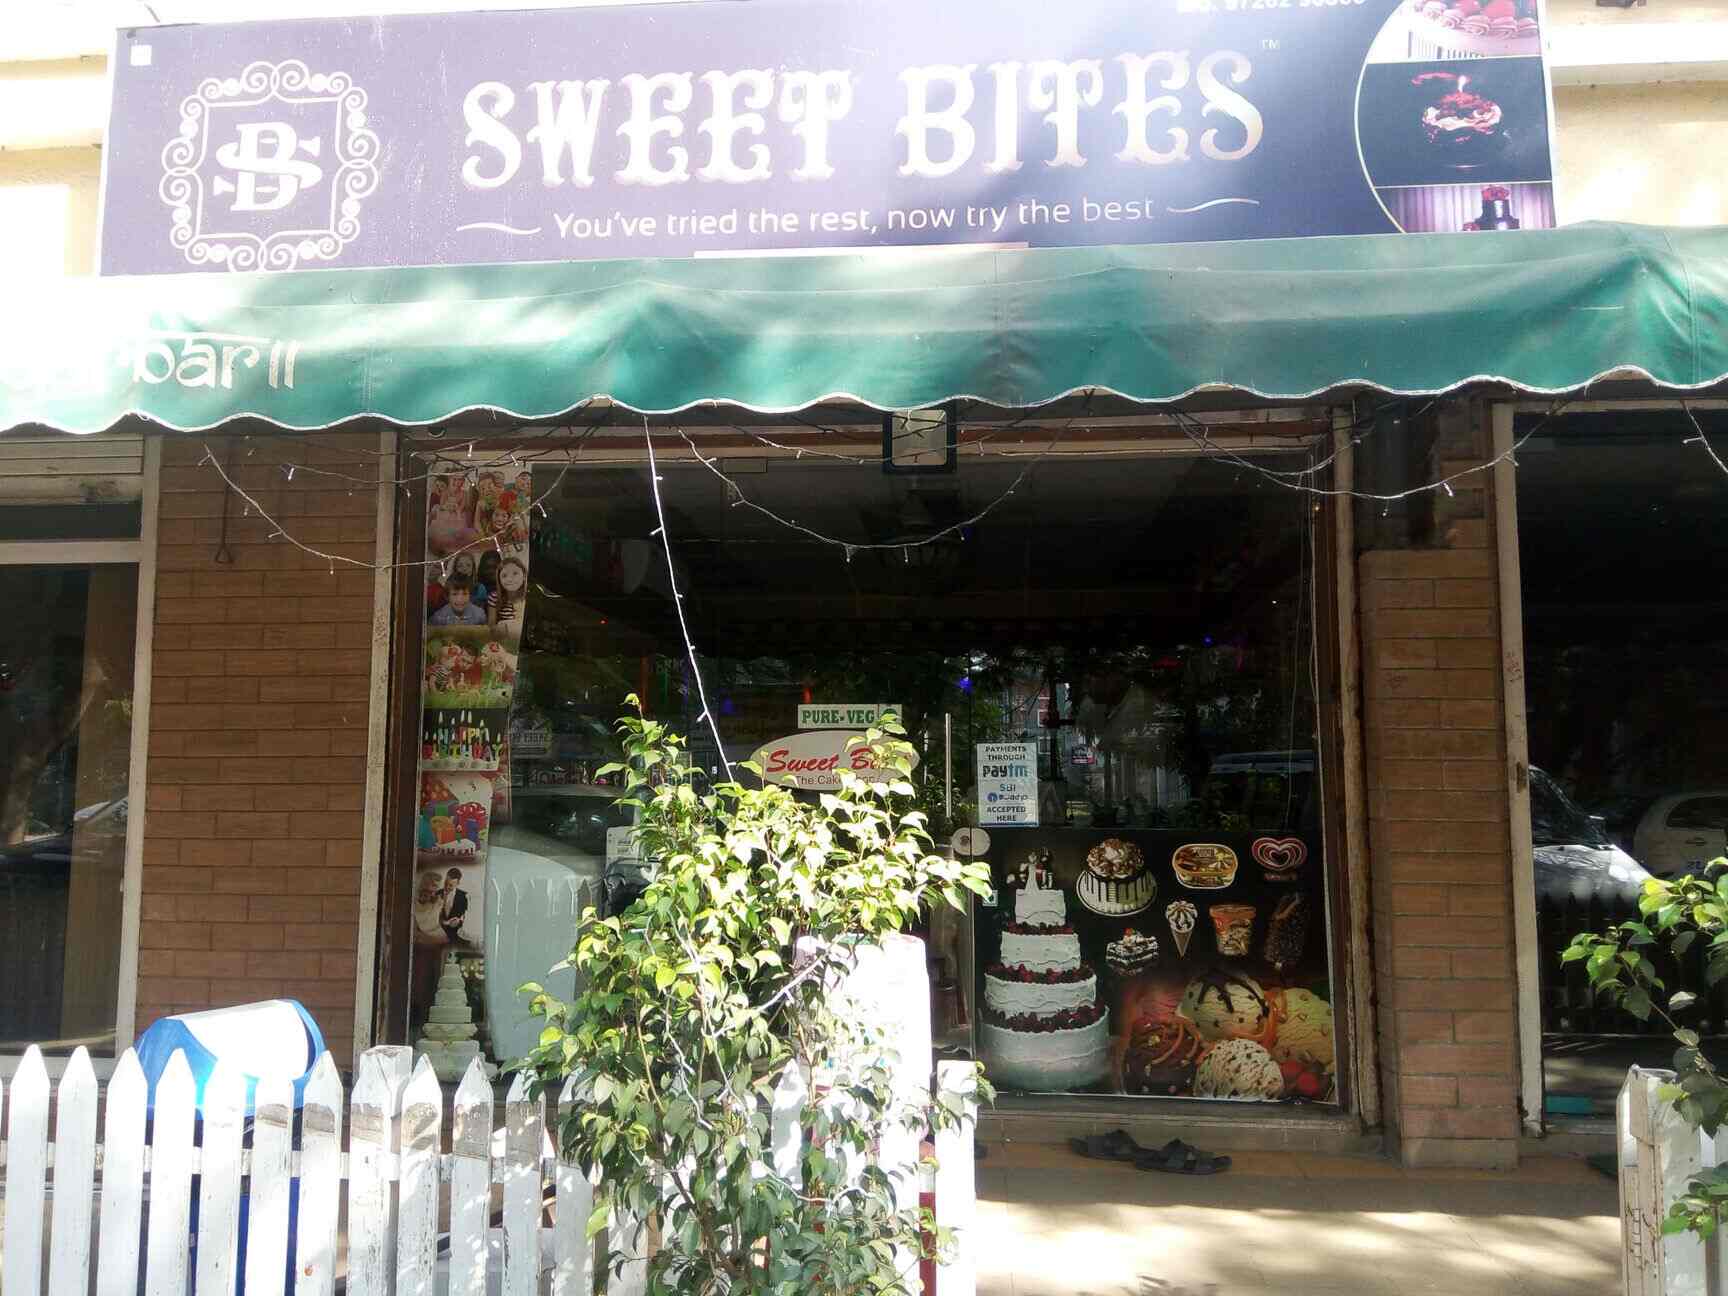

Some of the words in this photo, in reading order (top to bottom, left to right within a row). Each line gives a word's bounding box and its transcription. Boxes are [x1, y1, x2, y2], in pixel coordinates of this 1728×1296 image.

[461, 69, 853, 189] SWEET
[895, 50, 1264, 178] BITES
[553, 211, 657, 239] You've
[667, 209, 738, 235] tried
[748, 208, 799, 233] the
[809, 208, 877, 235] rest,
[887, 208, 955, 230] now
[966, 205, 1009, 232] try
[1018, 199, 1071, 224] the
[1083, 196, 1154, 222] best
[766, 749, 840, 773] Sweet
[986, 805, 1026, 813] ACCEPTED
